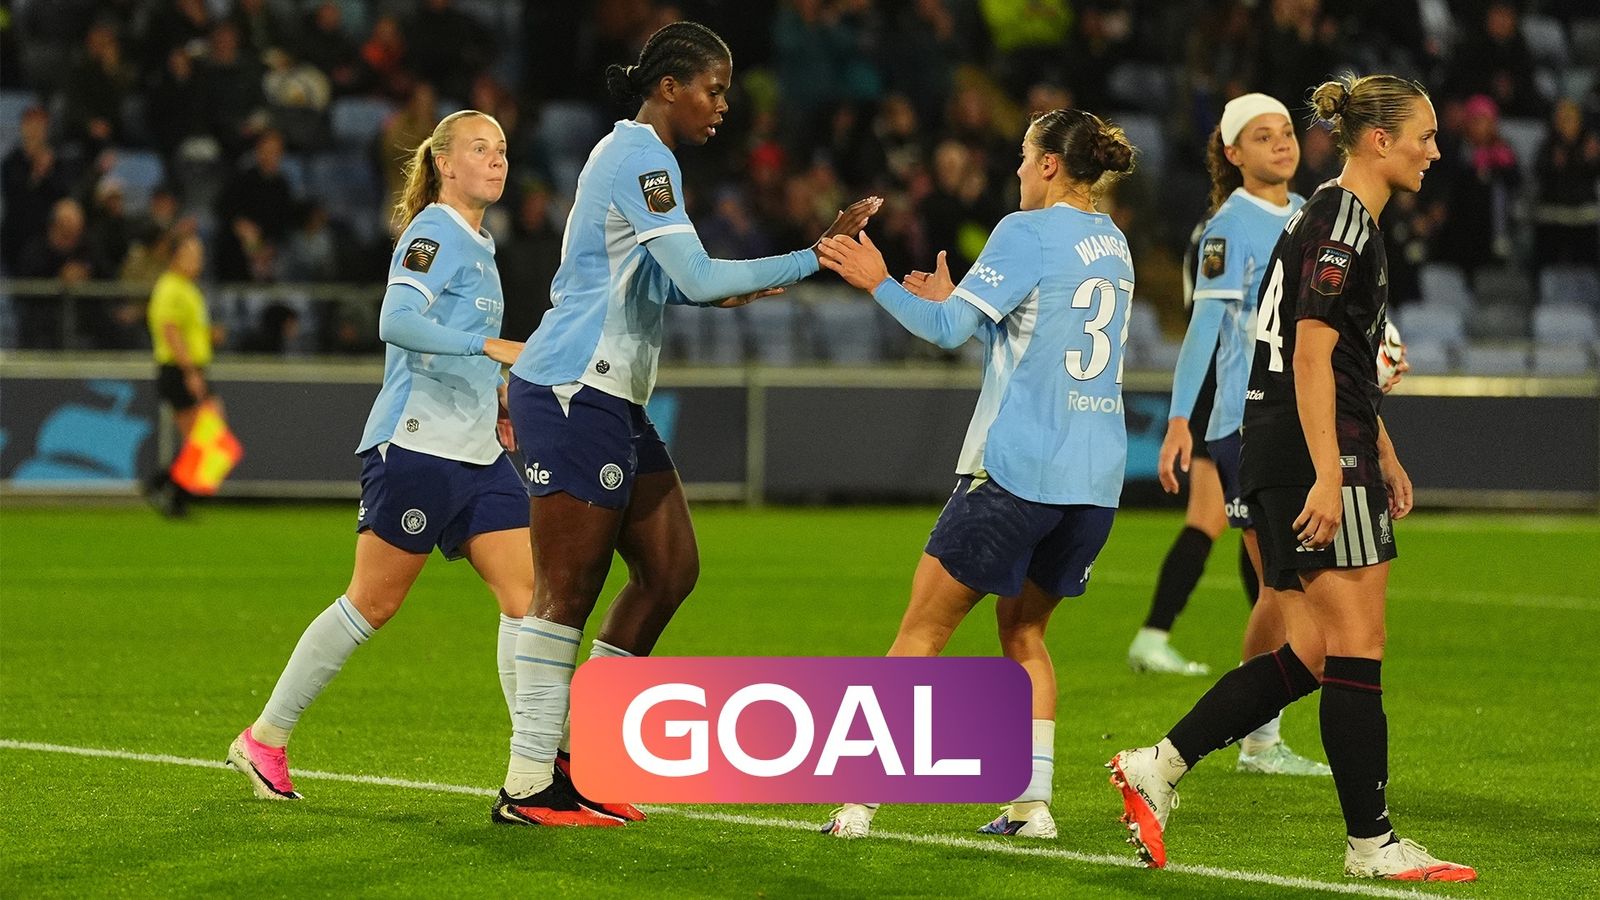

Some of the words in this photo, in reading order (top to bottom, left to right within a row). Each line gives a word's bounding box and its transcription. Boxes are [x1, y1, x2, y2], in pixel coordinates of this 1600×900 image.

[643, 176, 669, 189] WSL
[410, 241, 436, 254] WSL
[1318, 253, 1348, 268] WSL
[1064, 277, 1134, 384] 37
[1068, 391, 1124, 414] Revol
[525, 462, 550, 484] oie
[1136, 784, 1158, 812] ULTRA
